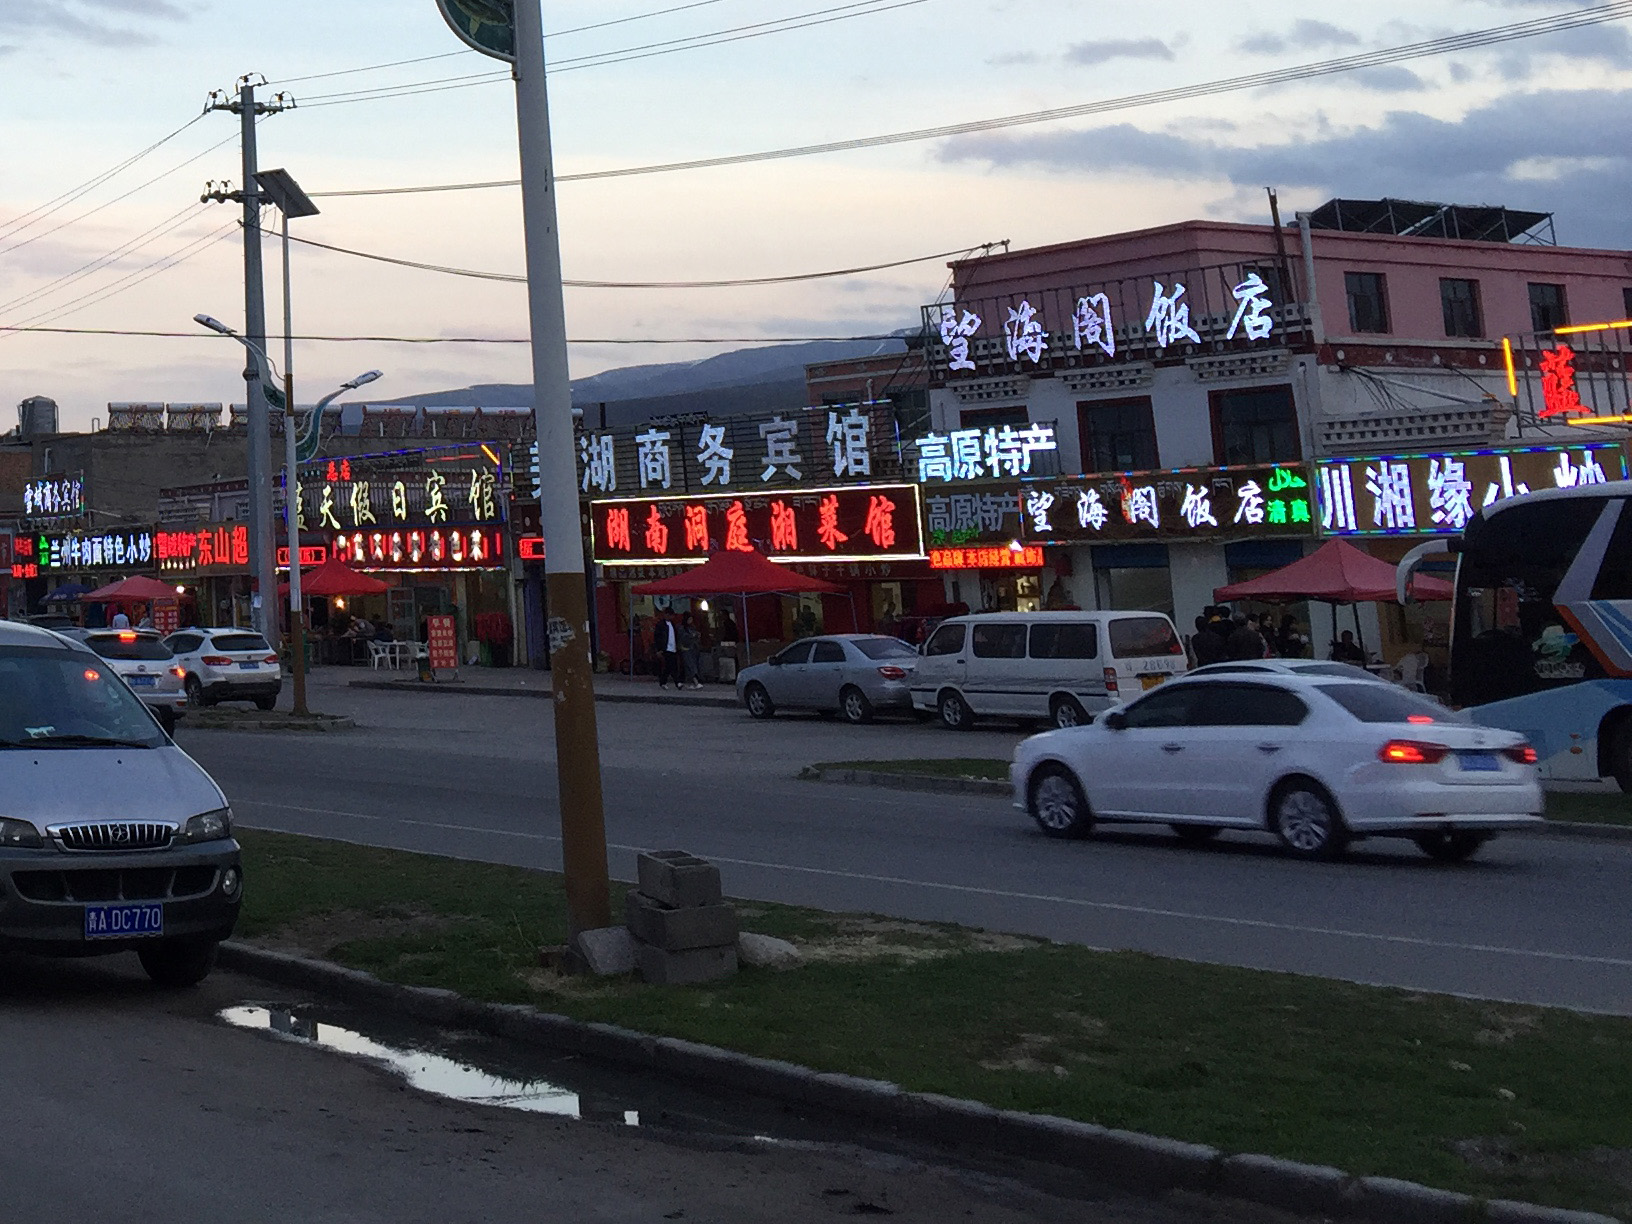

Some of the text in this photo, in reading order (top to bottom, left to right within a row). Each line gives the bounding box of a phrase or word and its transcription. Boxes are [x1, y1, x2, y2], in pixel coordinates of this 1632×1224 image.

[939, 272, 1274, 372] 望海阁饭店
[915, 422, 1058, 483] 高原特产
[606, 493, 898, 554] 湖南洞庭湘菜馆
[926, 491, 1020, 533] 高原特产
[1026, 479, 1267, 533] 望海阁饭店
[50, 531, 152, 568] 兰州牛肉面特色小炒
[198, 526, 249, 566] 东山超
